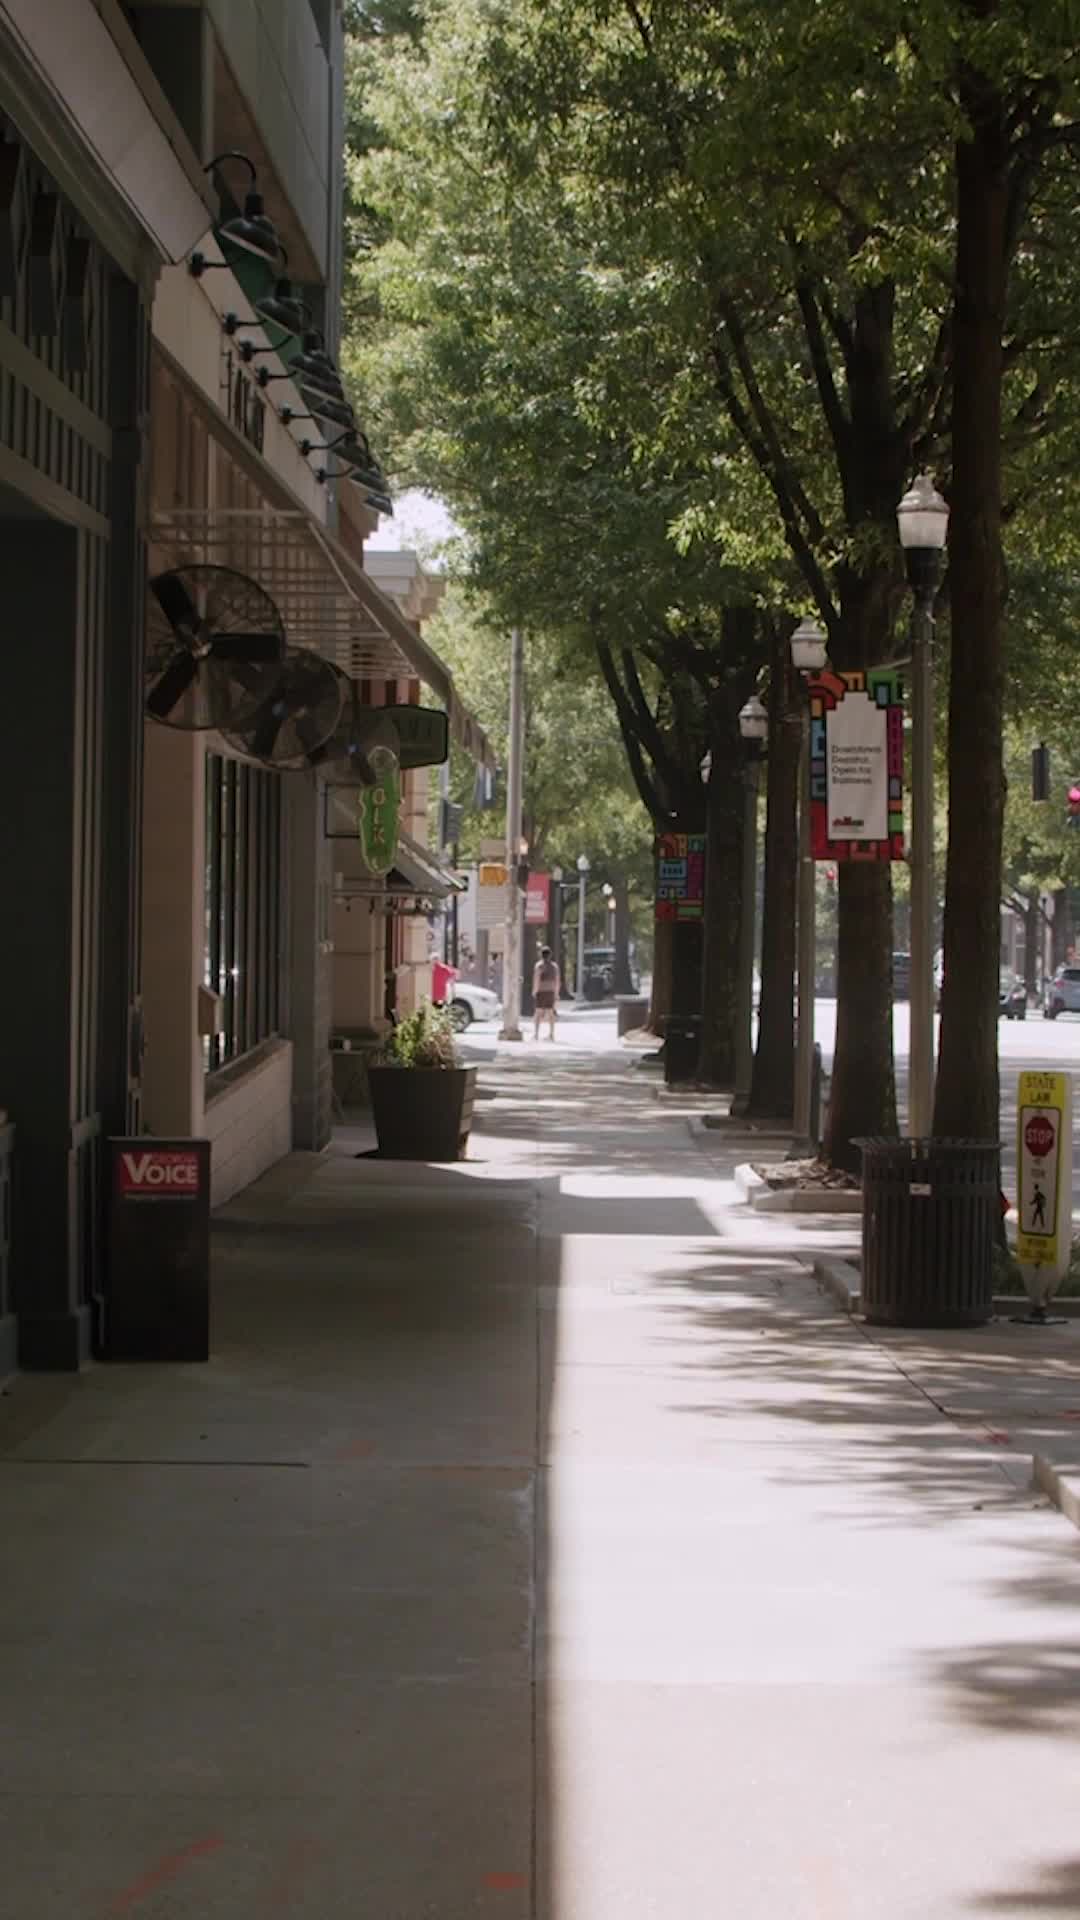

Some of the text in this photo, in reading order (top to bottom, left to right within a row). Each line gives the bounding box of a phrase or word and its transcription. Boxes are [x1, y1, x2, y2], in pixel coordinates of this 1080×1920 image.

[832, 766, 857, 776] Open
[1025, 1076, 1057, 1089] STATE
[1029, 1091, 1051, 1104] LAW
[1026, 1128, 1053, 1145] STOP
[121, 1153, 198, 1185] VOICE
